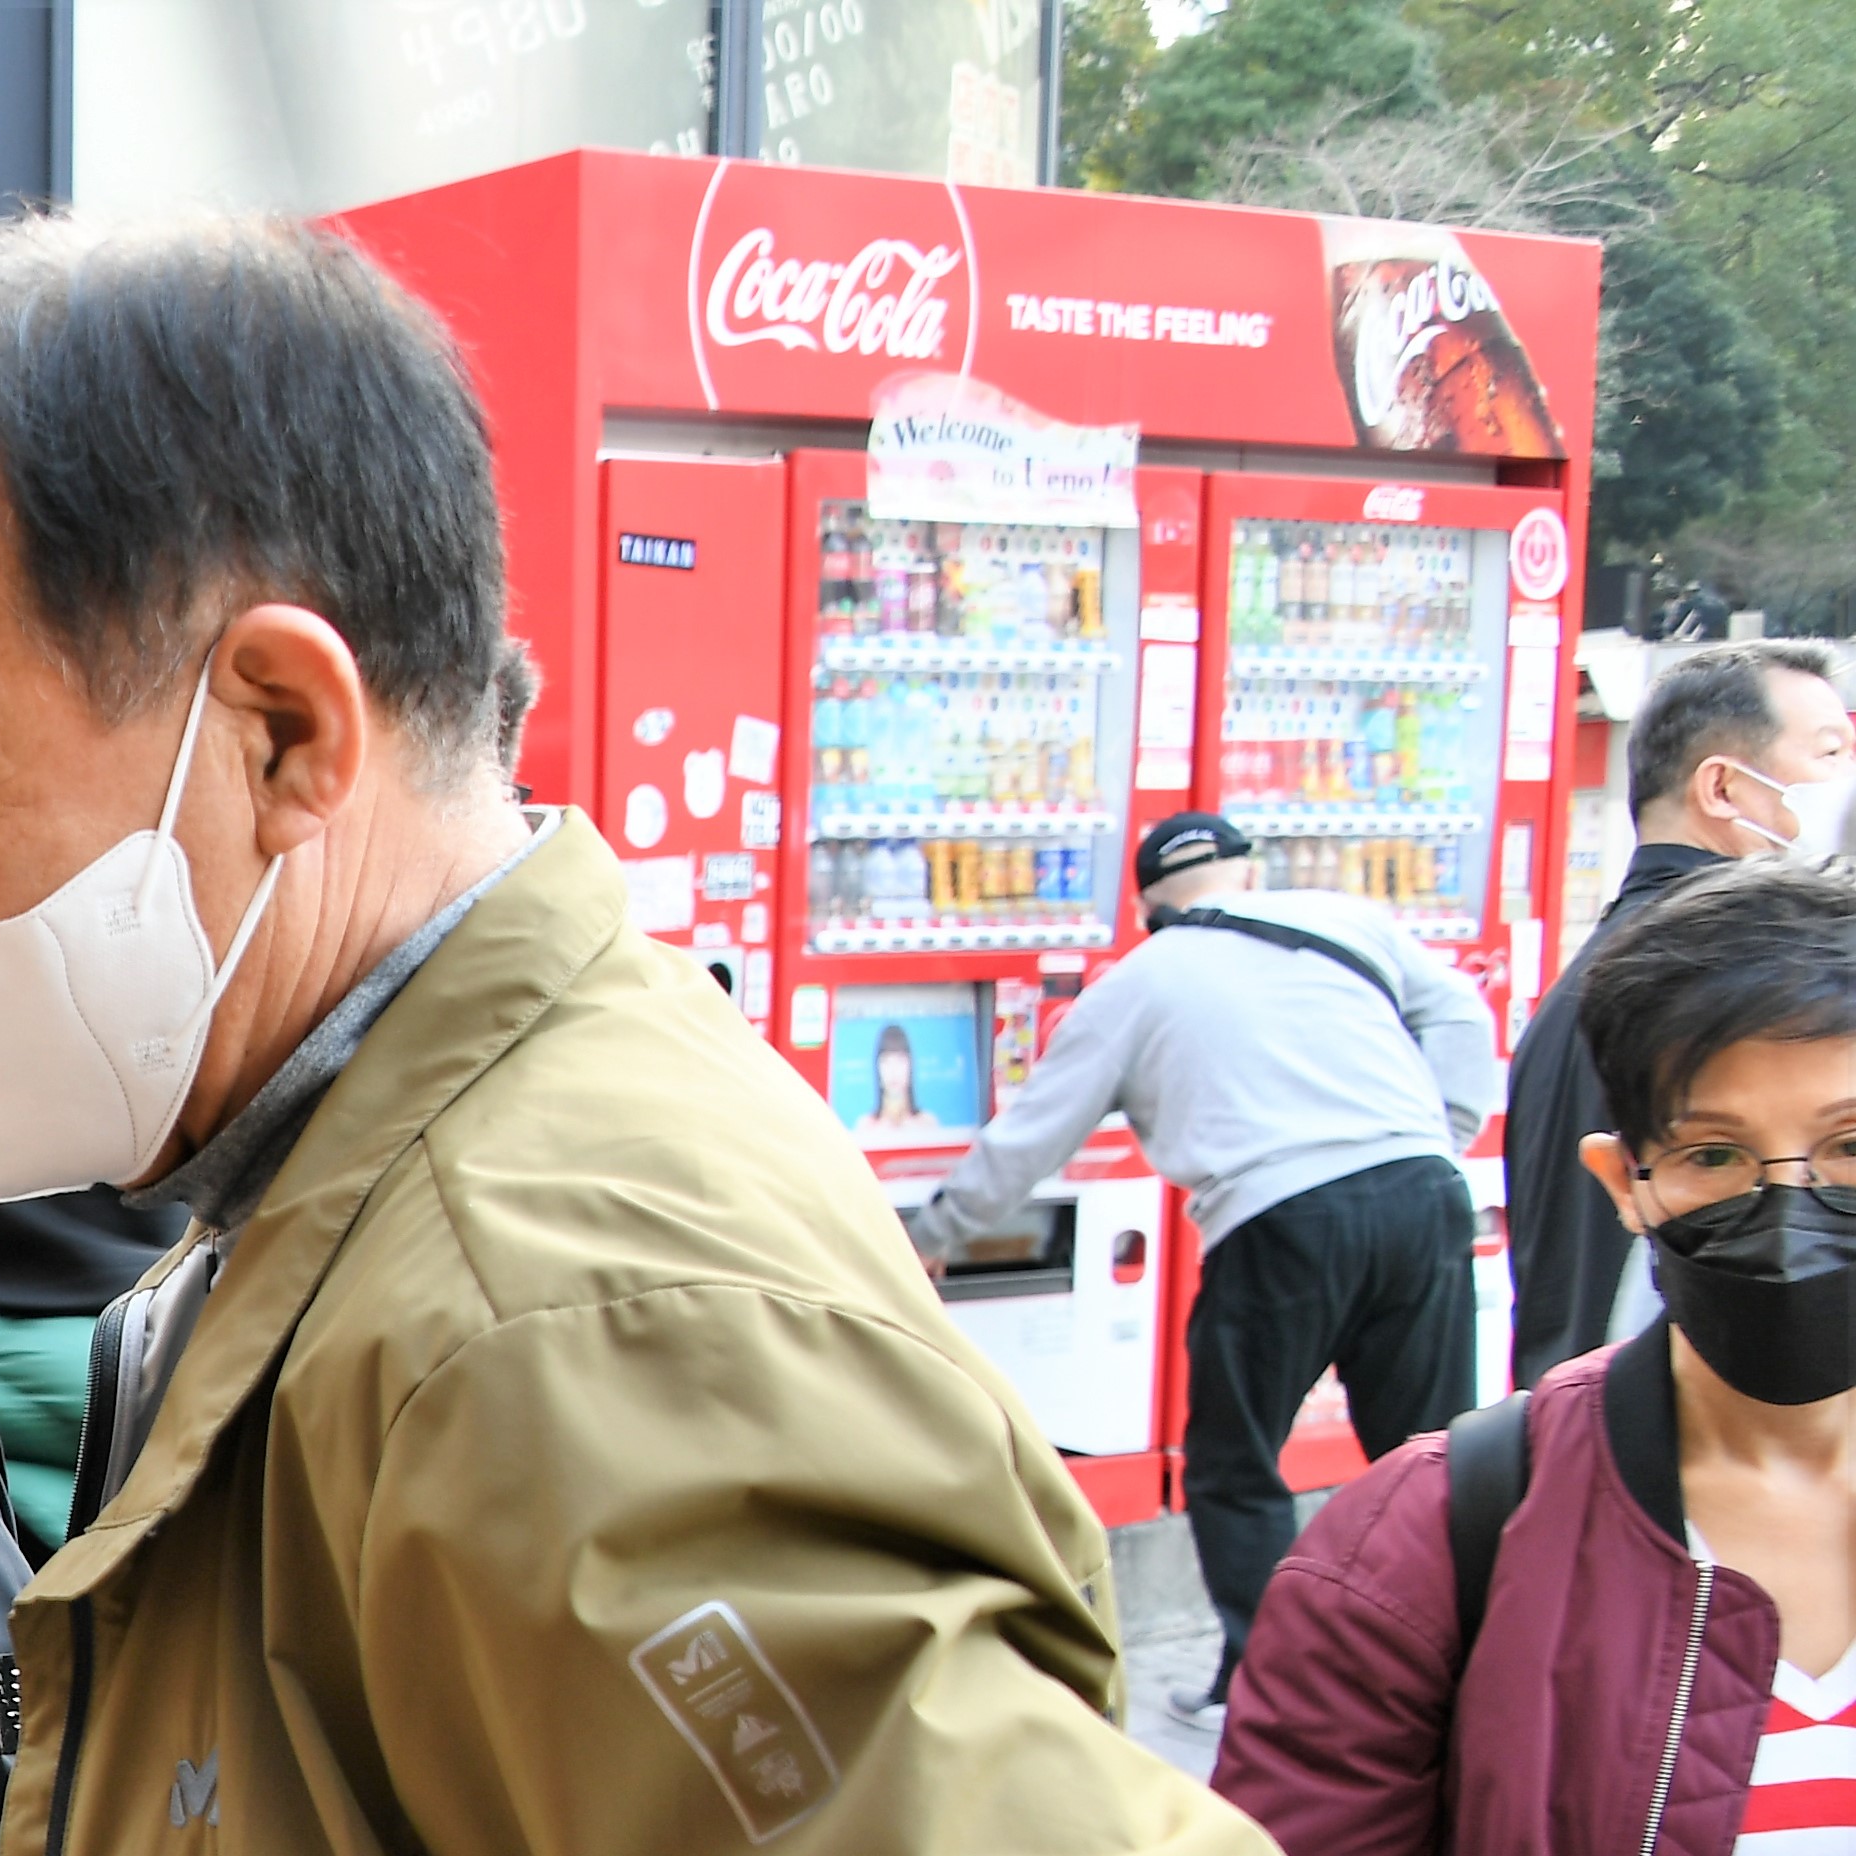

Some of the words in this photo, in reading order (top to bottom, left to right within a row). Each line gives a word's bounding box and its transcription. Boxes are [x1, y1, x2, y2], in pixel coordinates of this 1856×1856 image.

[705, 227, 963, 362] Coca-Cola
[1005, 293, 1095, 336] TASTE
[1096, 300, 1153, 341] THE
[1154, 306, 1270, 348] FEELING
[893, 411, 1014, 454] Welcome
